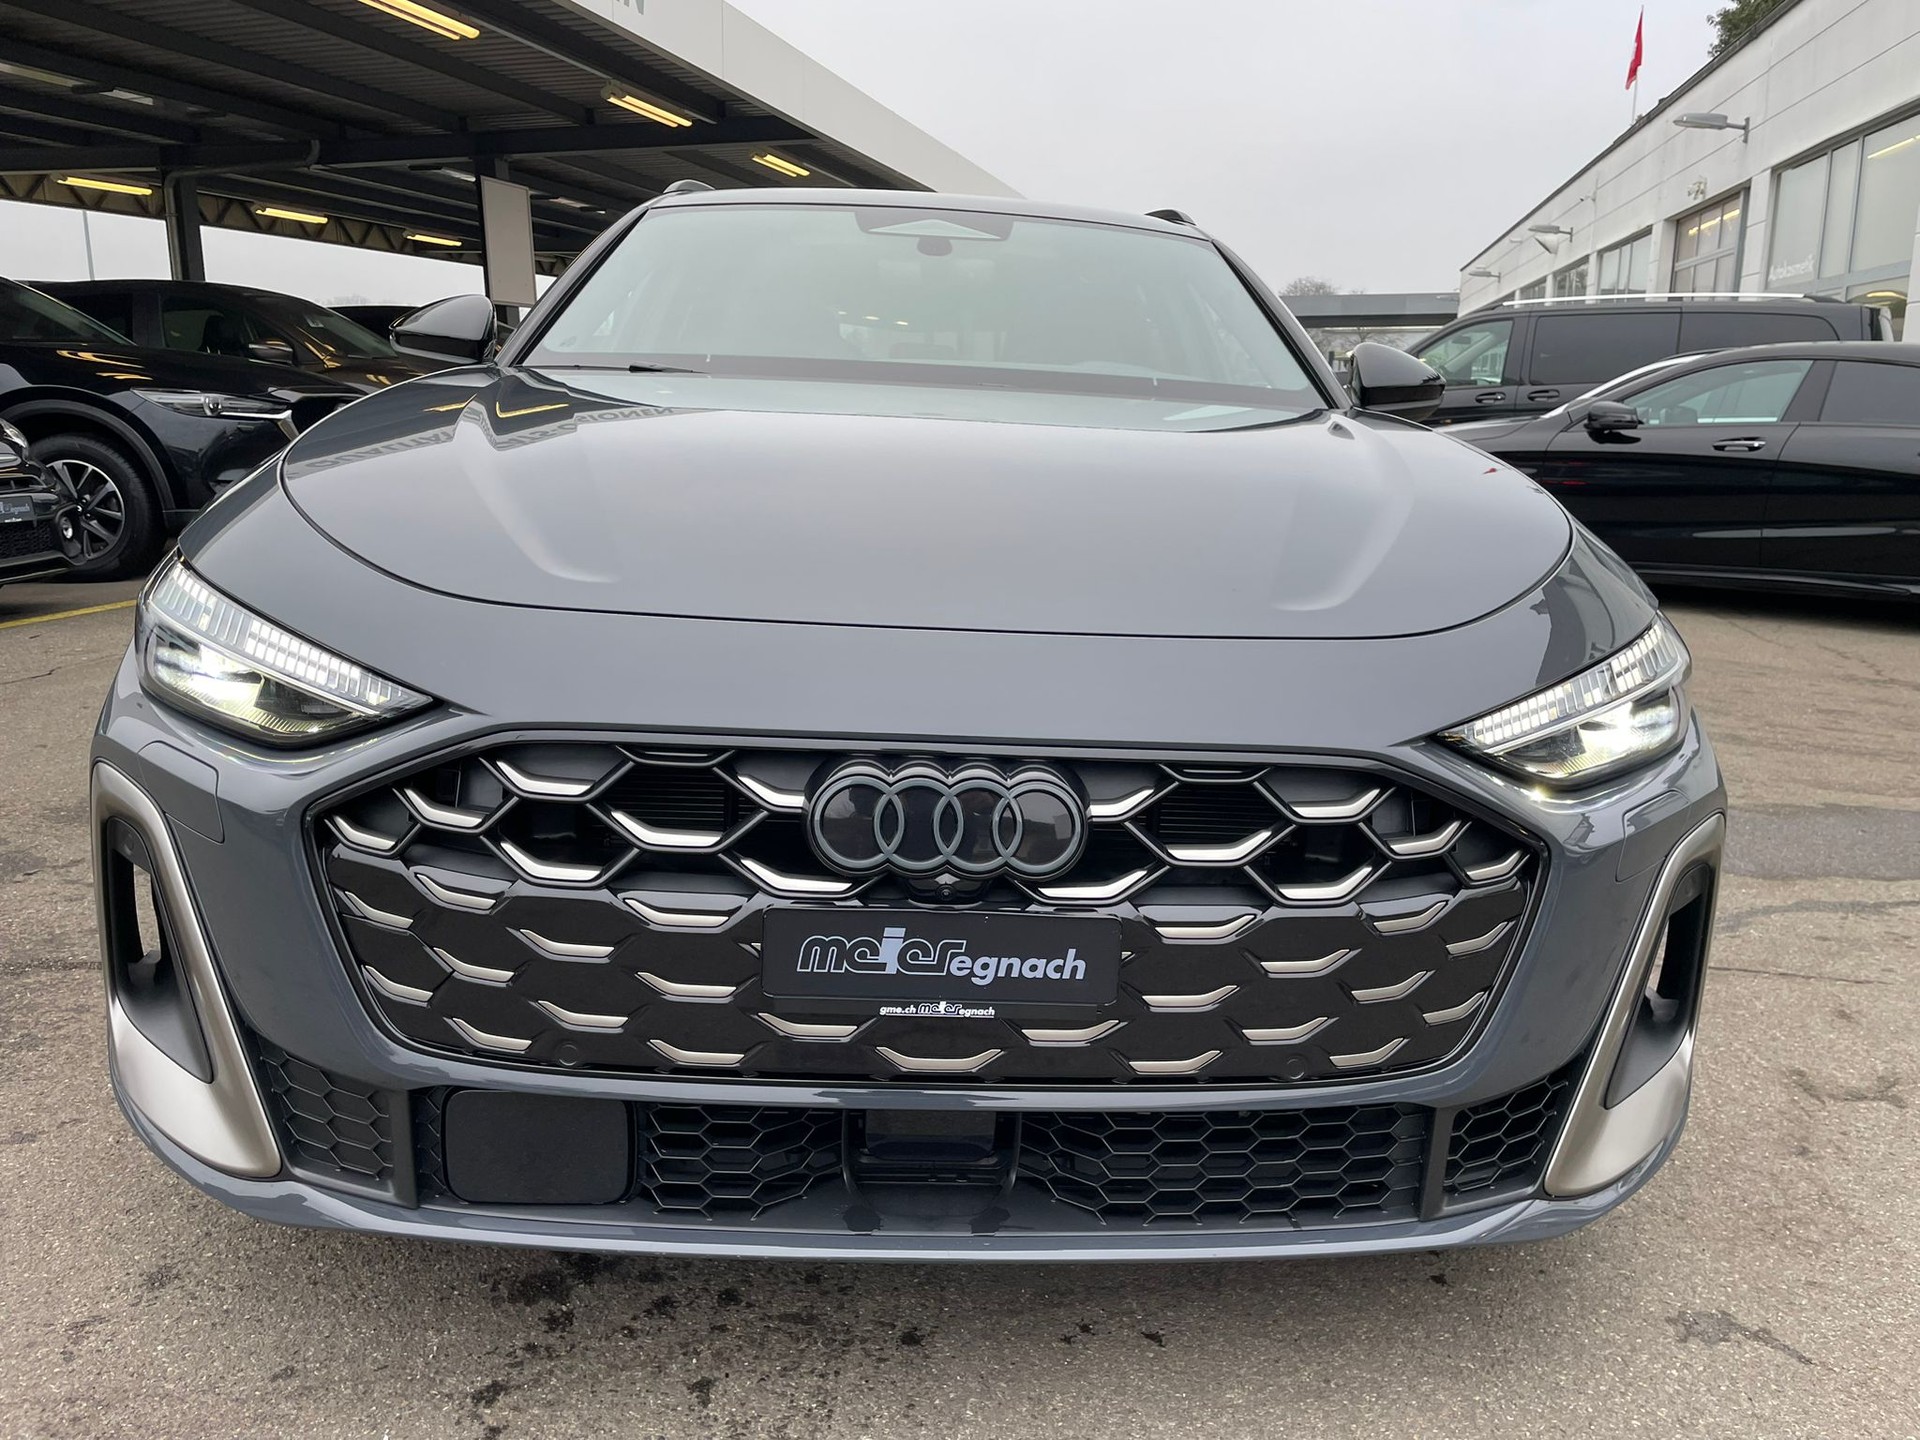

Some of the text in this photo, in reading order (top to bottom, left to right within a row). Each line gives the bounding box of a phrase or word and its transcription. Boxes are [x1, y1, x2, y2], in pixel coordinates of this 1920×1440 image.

[949, 948, 1086, 985] egnach
[880, 1004, 916, 1016] gme.ch
[959, 1006, 995, 1017] egnach
